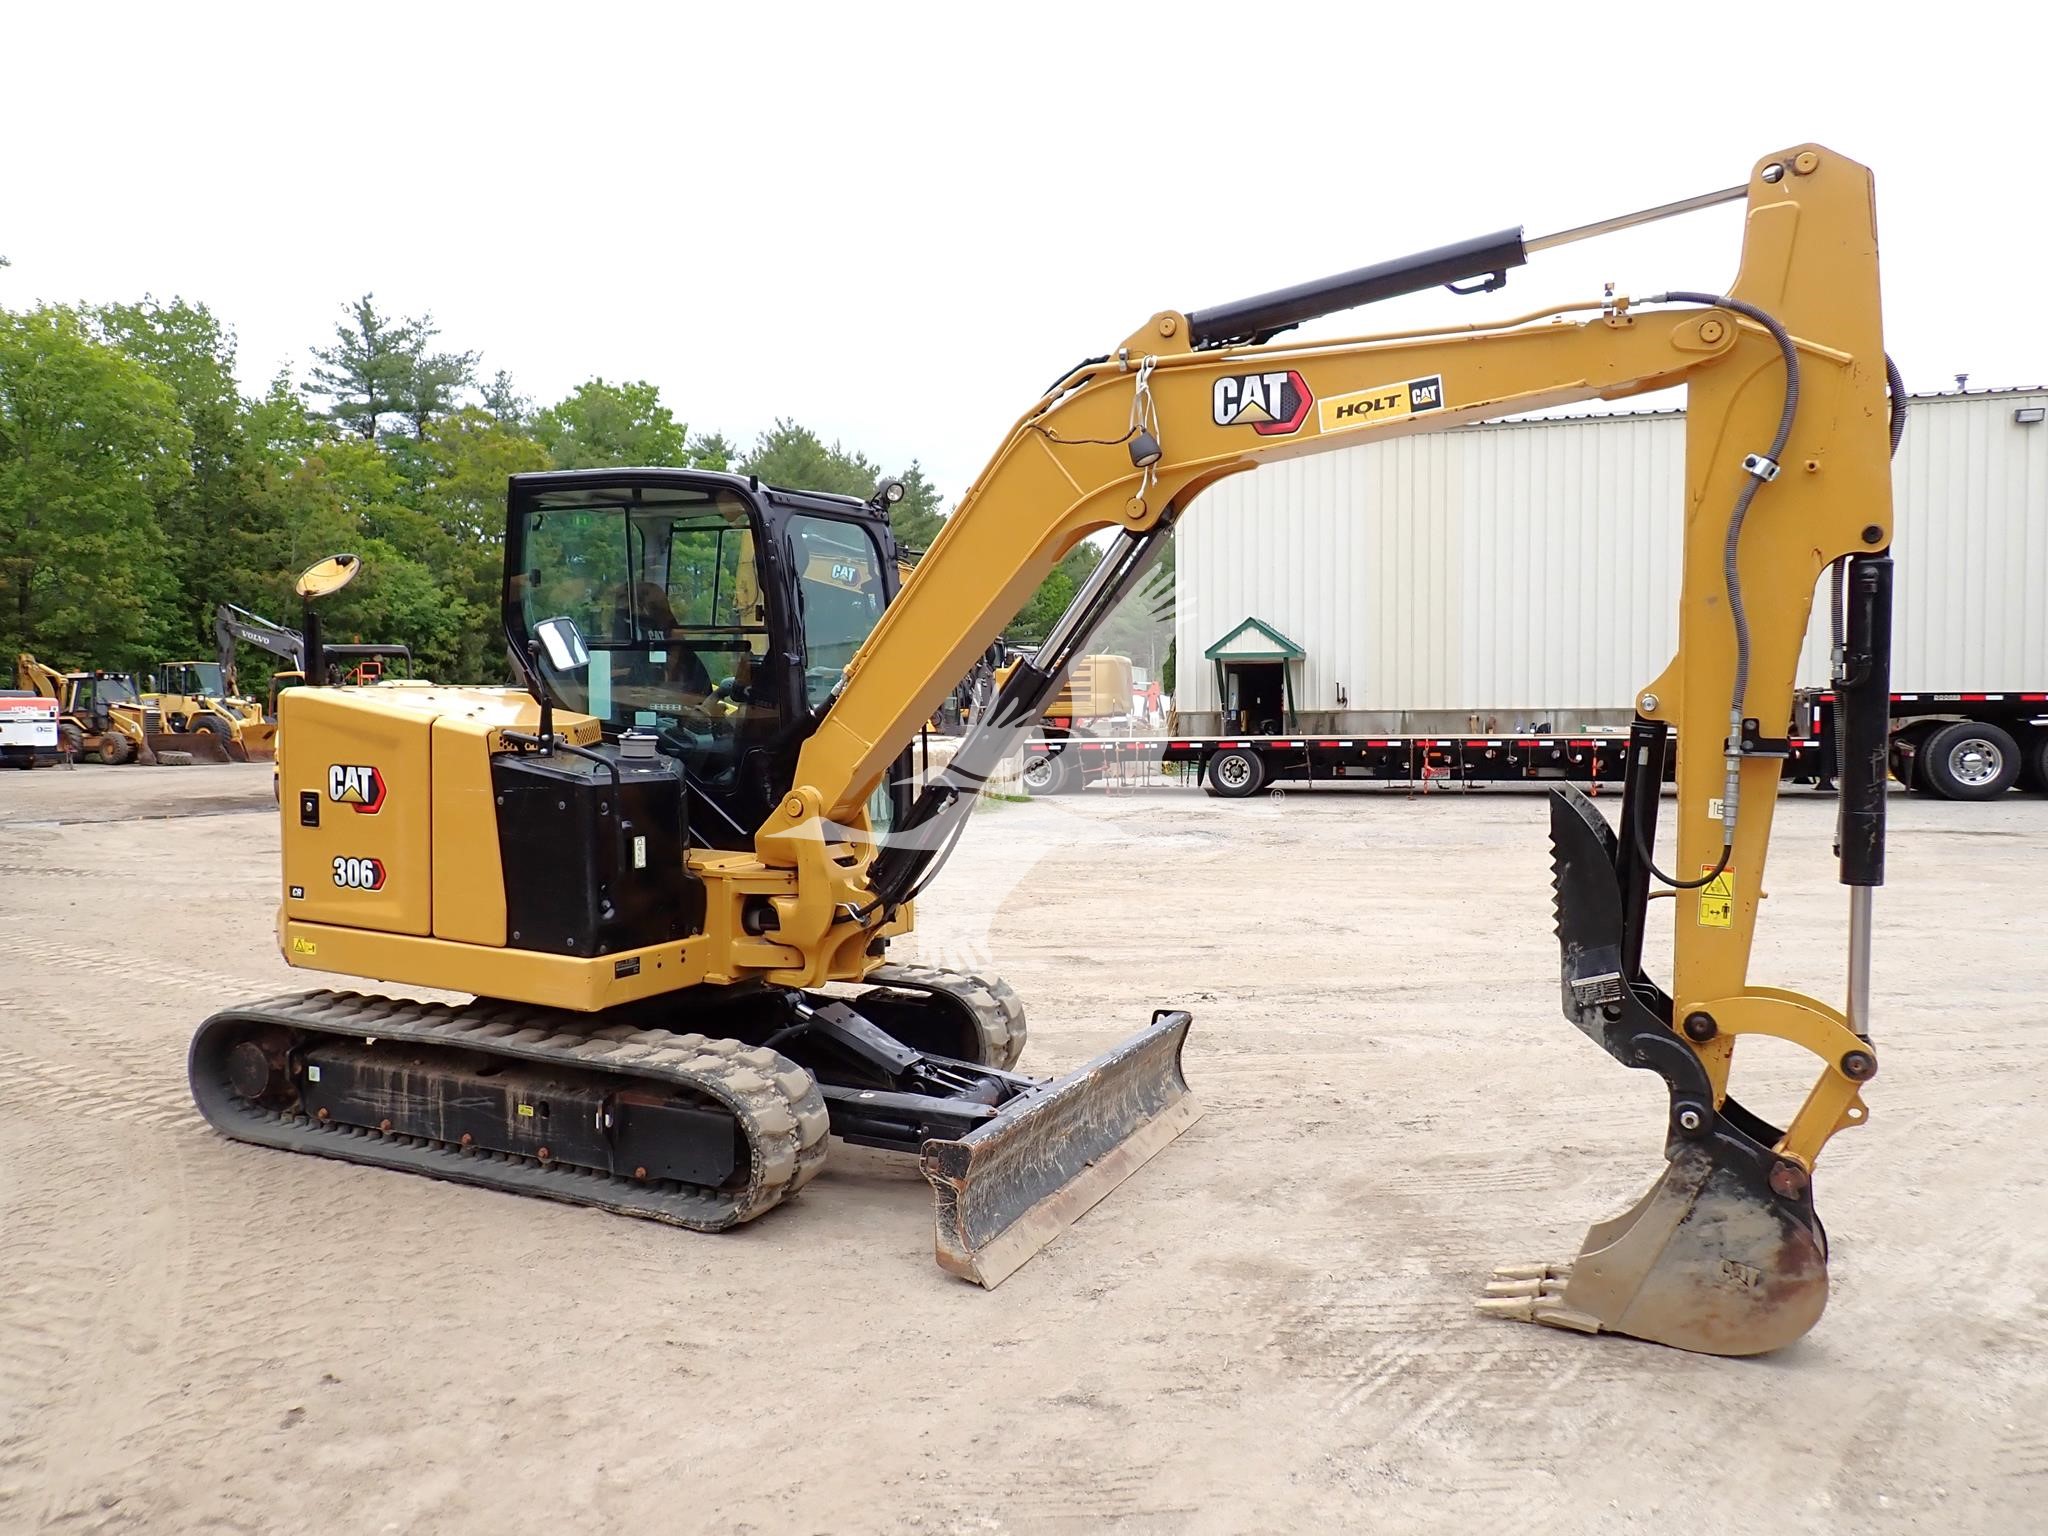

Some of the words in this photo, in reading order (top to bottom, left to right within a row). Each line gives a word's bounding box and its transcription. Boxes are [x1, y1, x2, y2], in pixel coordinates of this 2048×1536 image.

[1214, 372, 1288, 425] CAT
[1336, 394, 1402, 419] HOLT
[1411, 385, 1438, 405] CAT
[832, 564, 856, 582] CAT
[242, 630, 270, 645] VOLVO
[329, 765, 372, 803] CAT
[333, 857, 374, 888] 306
